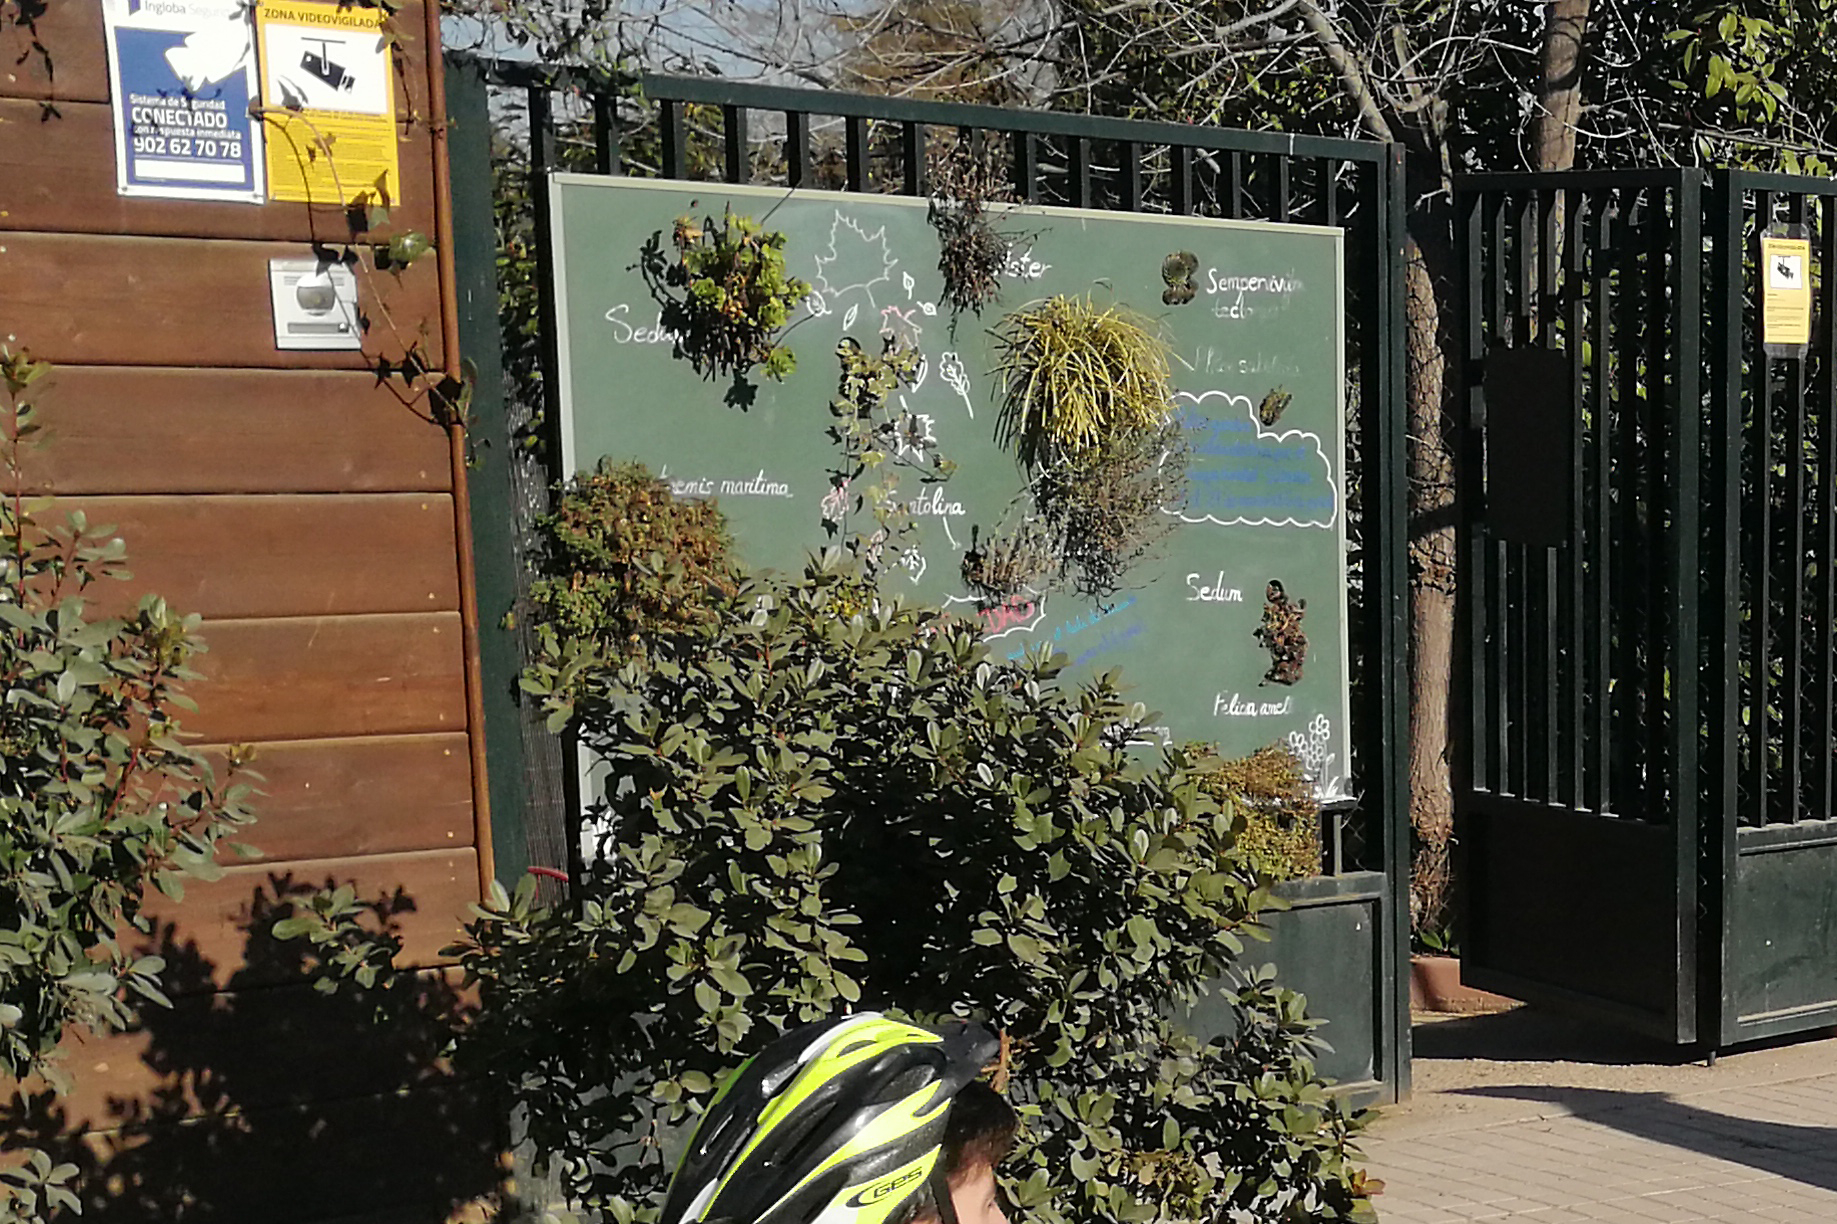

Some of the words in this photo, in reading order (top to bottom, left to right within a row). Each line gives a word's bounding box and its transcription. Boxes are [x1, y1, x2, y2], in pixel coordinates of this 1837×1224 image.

[145, 0, 186, 15] Ingloba
[264, 8, 295, 21] ZONA
[298, 12, 382, 29] VIDEOVIGILADA
[130, 93, 166, 105] Sistema
[167, 96, 179, 107] de
[181, 97, 225, 110] Sguridad
[132, 106, 227, 128] CONECTADO
[197, 129, 242, 140] inmediata
[134, 138, 166, 153] 902
[169, 139, 191, 155] 62
[194, 140, 216, 156] 70
[220, 141, 241, 158] 78
[605, 304, 680, 344] Sedu
[1186, 571, 1243, 602] Sedum
